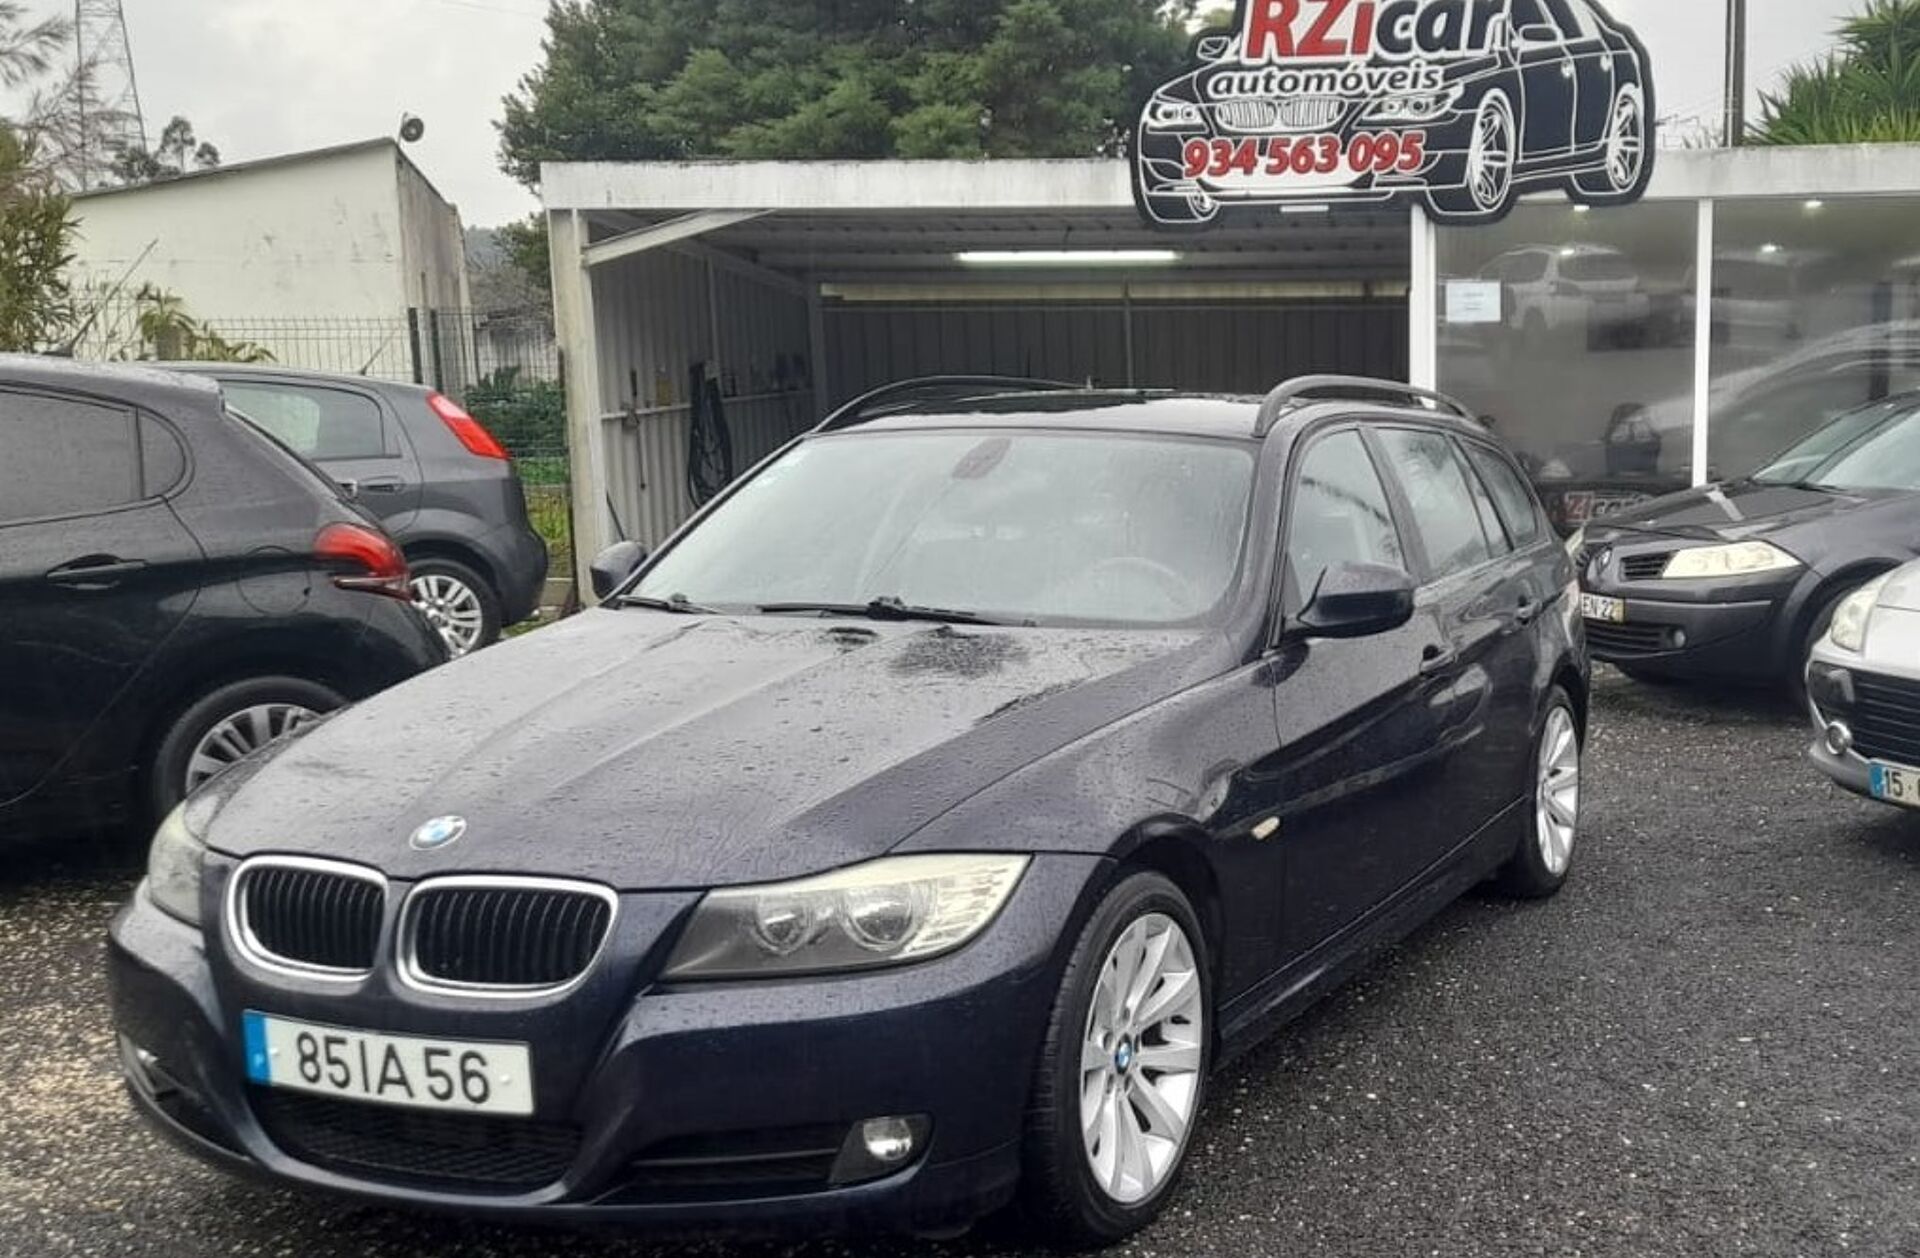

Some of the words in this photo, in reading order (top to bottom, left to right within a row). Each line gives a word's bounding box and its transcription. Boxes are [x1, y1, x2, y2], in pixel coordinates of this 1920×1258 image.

[1211, 61, 1441, 95] automóveis
[1183, 138, 1256, 177] 934
[1266, 135, 1341, 174] 563
[1348, 132, 1425, 172] 095
